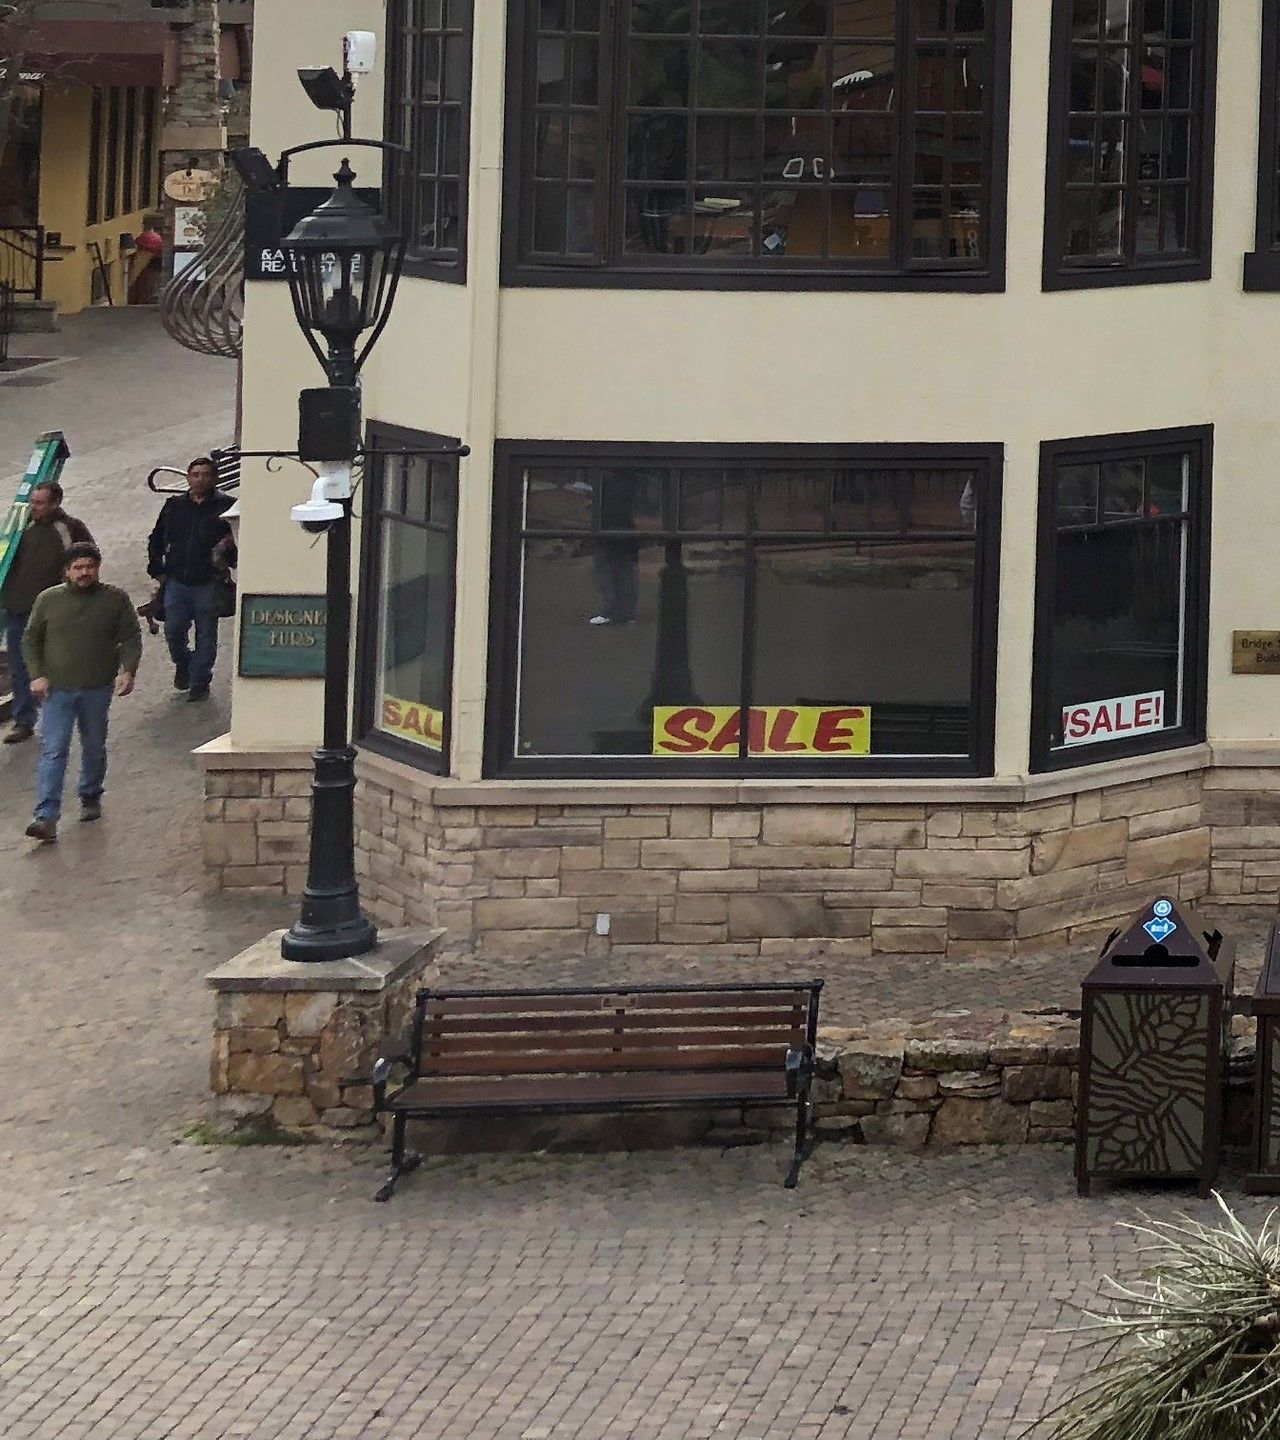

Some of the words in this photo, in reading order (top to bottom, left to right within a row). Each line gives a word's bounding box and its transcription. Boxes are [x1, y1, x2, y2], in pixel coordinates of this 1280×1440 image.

[1241, 638, 1273, 651] Bridge
[383, 700, 442, 741] SAL
[657, 708, 865, 753] SALE
